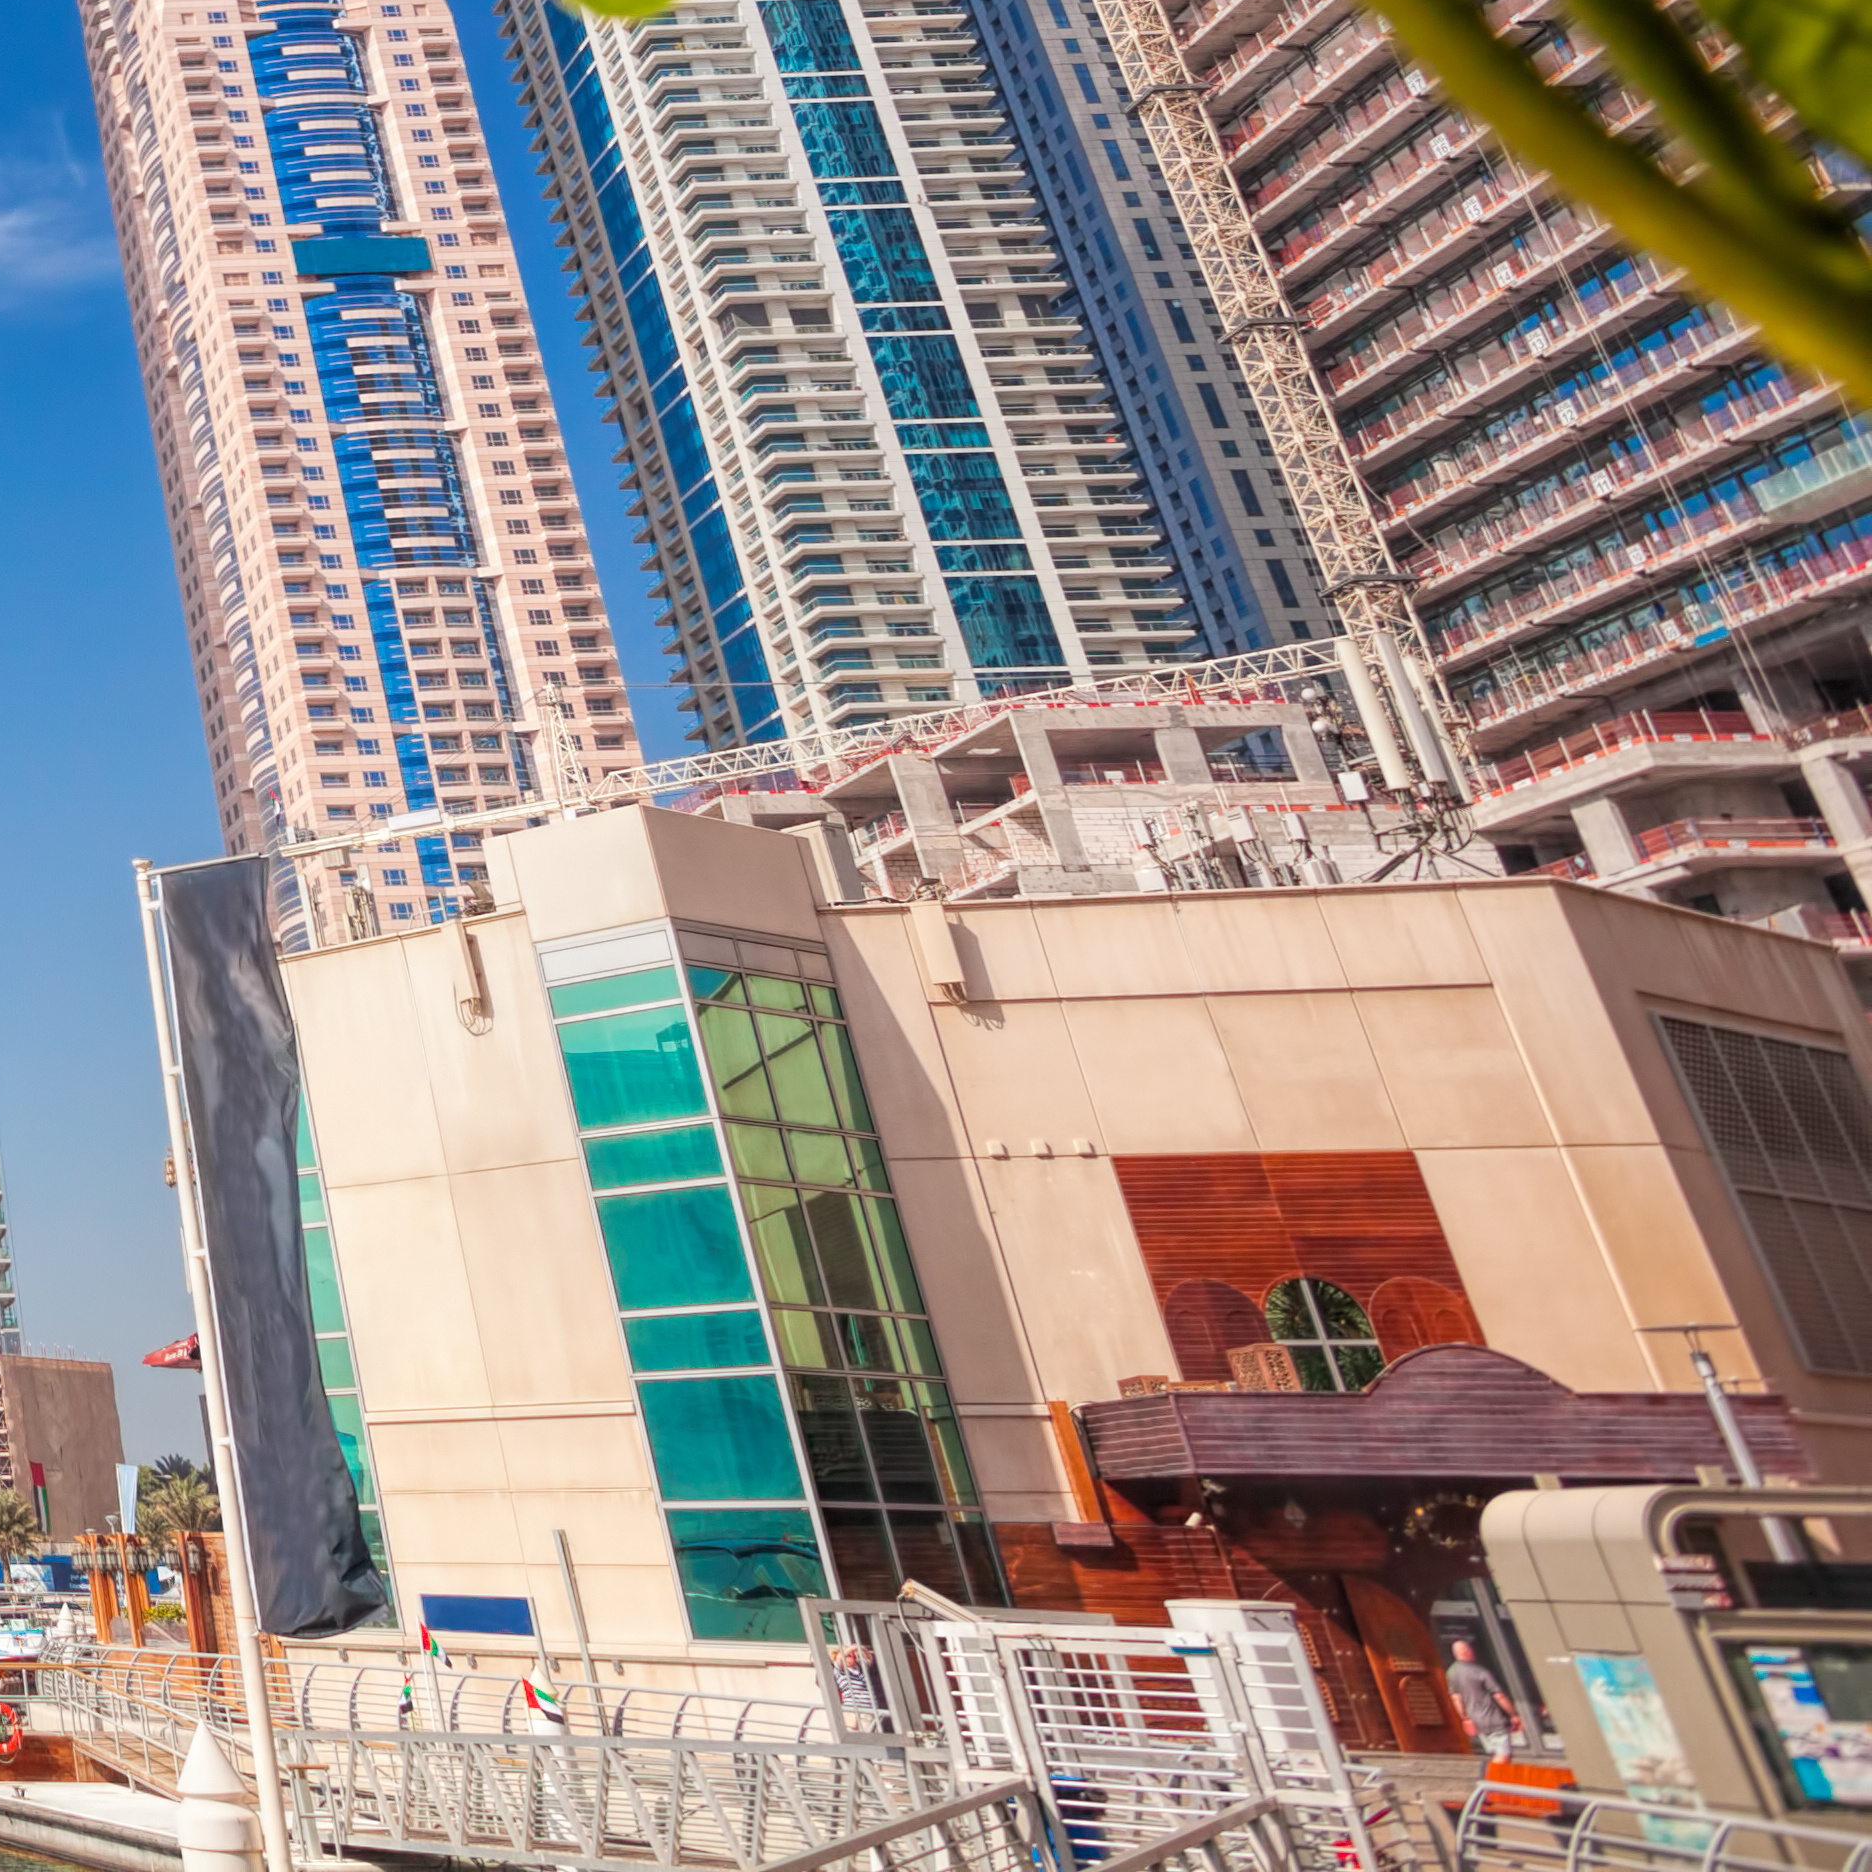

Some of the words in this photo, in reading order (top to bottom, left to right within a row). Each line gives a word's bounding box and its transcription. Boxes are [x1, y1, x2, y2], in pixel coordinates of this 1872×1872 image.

[1411, 78, 1423, 92] 17
[1435, 142, 1449, 156] 16
[1467, 204, 1480, 218] 15
[1498, 271, 1511, 284] 14
[1532, 338, 1545, 351] 13
[1562, 409, 1576, 423] 12
[1597, 479, 1610, 493] 11
[1632, 552, 1643, 563] 10
